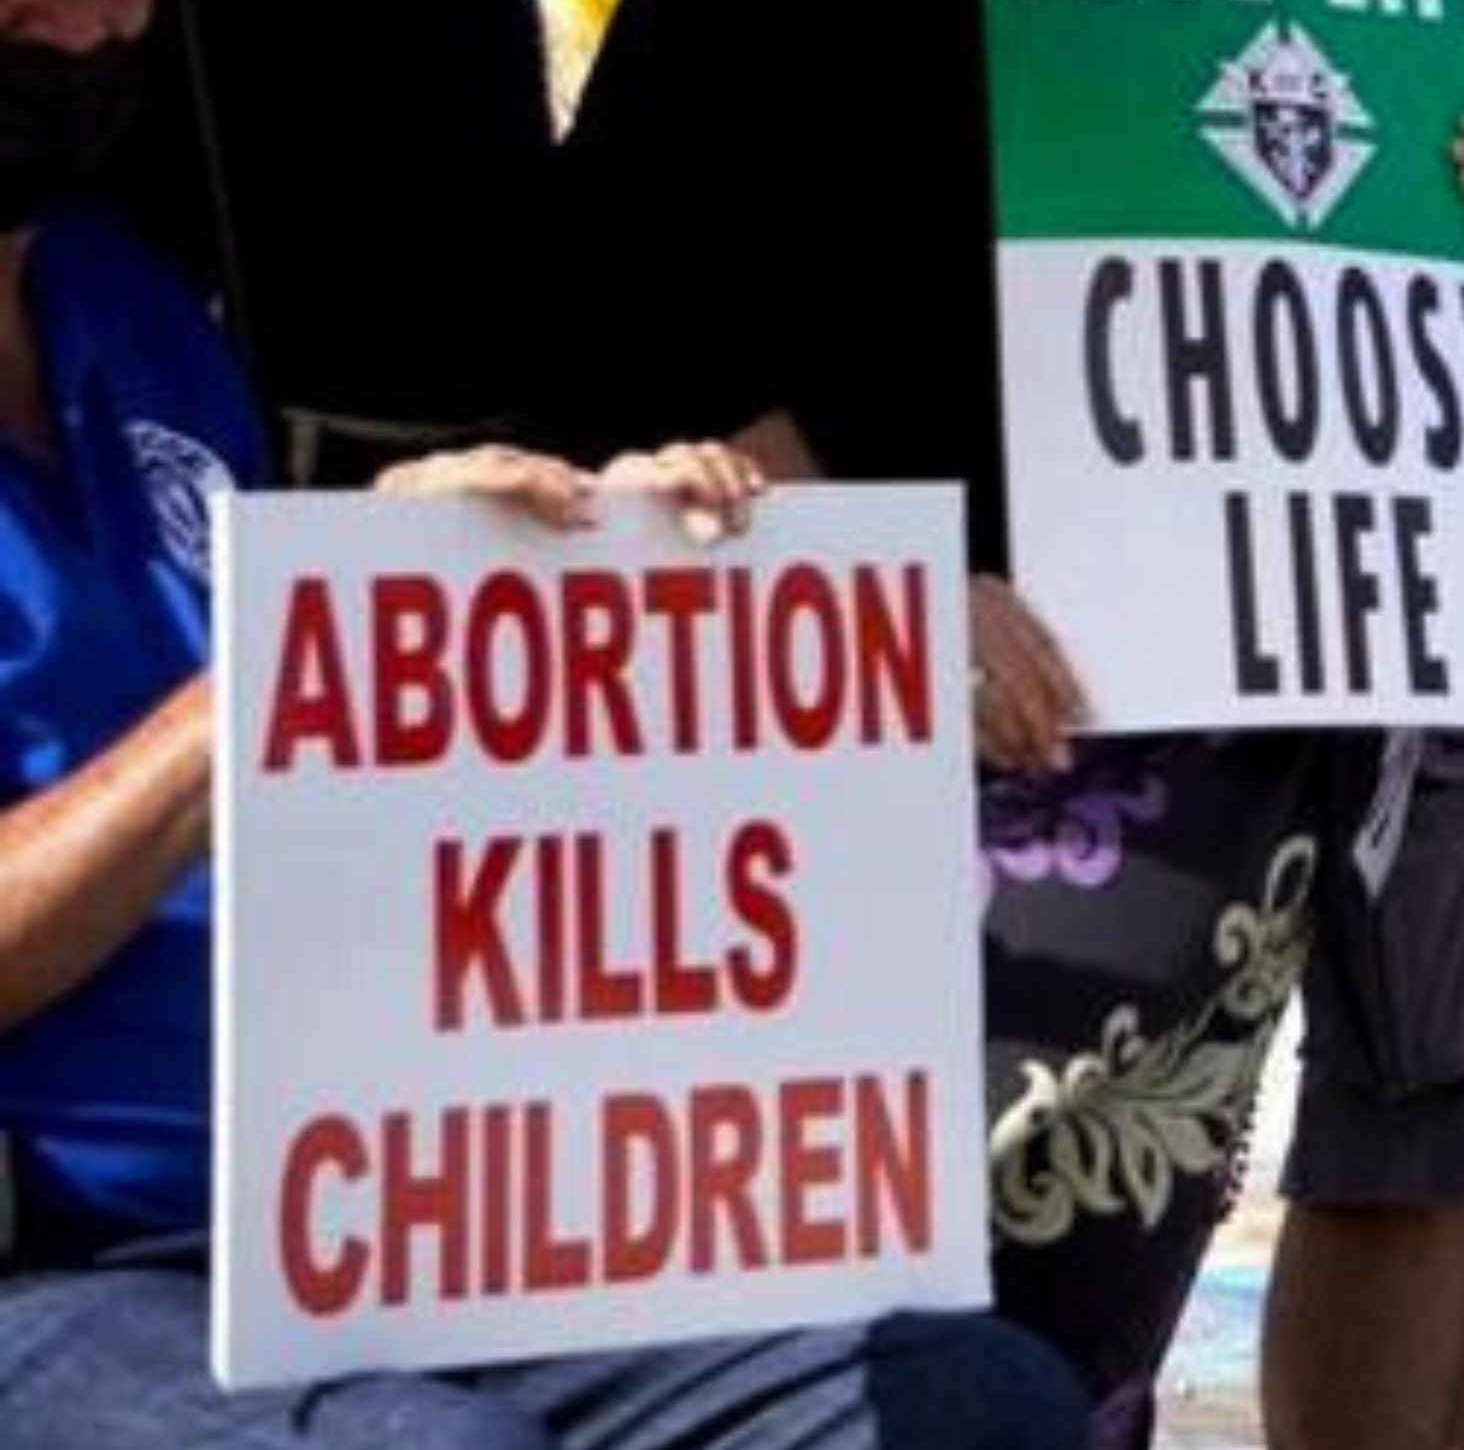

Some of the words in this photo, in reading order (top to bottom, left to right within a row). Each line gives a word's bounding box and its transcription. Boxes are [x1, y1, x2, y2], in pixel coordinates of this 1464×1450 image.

[260, 561, 933, 773] ABORTION
[1226, 492, 1449, 697] LIFE
[431, 817, 799, 1033] KILLS
[276, 1070, 933, 1319] CHILDREN
